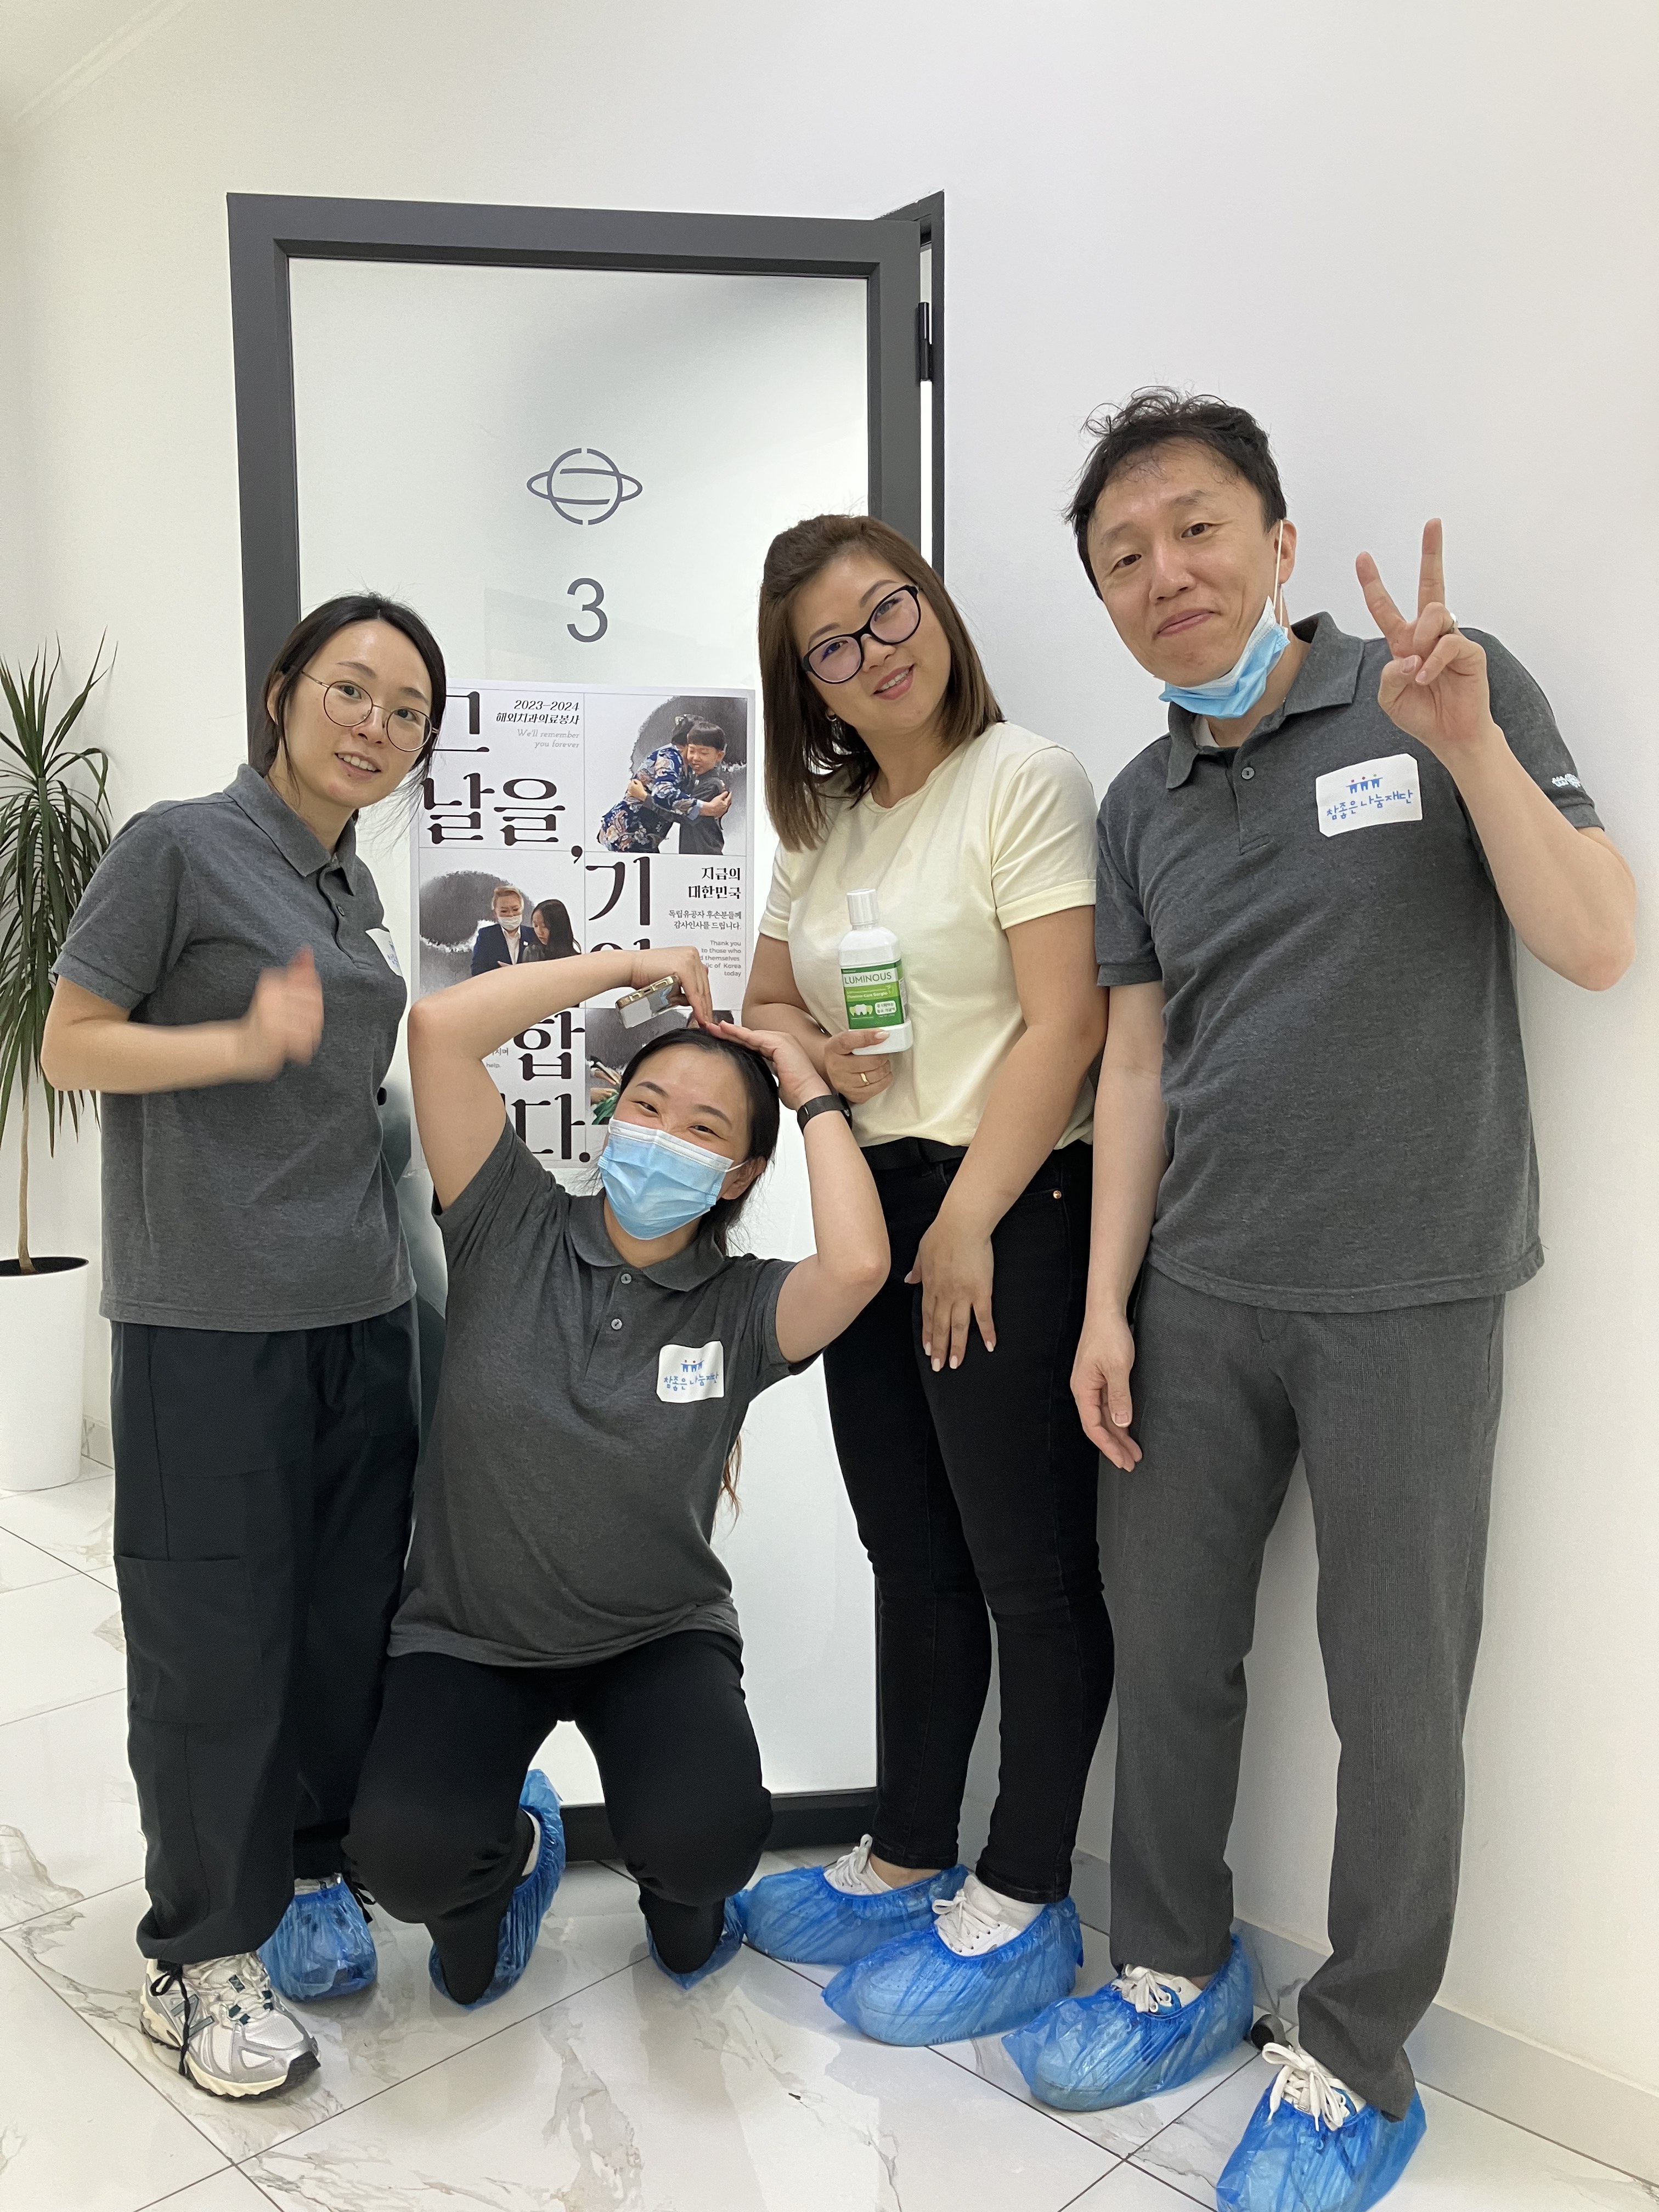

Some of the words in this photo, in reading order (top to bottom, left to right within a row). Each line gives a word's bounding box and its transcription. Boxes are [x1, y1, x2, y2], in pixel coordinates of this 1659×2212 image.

[567, 578, 608, 642] 3
[496, 712, 580, 725] 해외치과의료봉사
[517, 729, 538, 737] We'll
[540, 730, 579, 738] remember
[551, 740, 579, 748] forever
[1327, 800, 1358, 821] 참좋은
[1360, 789, 1413, 809] 나눔재단
[701, 866, 741, 881] 지금의
[585, 856, 650, 926] 기
[688, 885, 741, 899] 대한민국
[668, 910, 705, 918] 독립유공자
[674, 920, 710, 930] 감사인사를
[711, 921, 742, 930] 드립니다.
[844, 972, 892, 984] LUMINOUS
[664, 1375, 687, 1391] 참좋은
